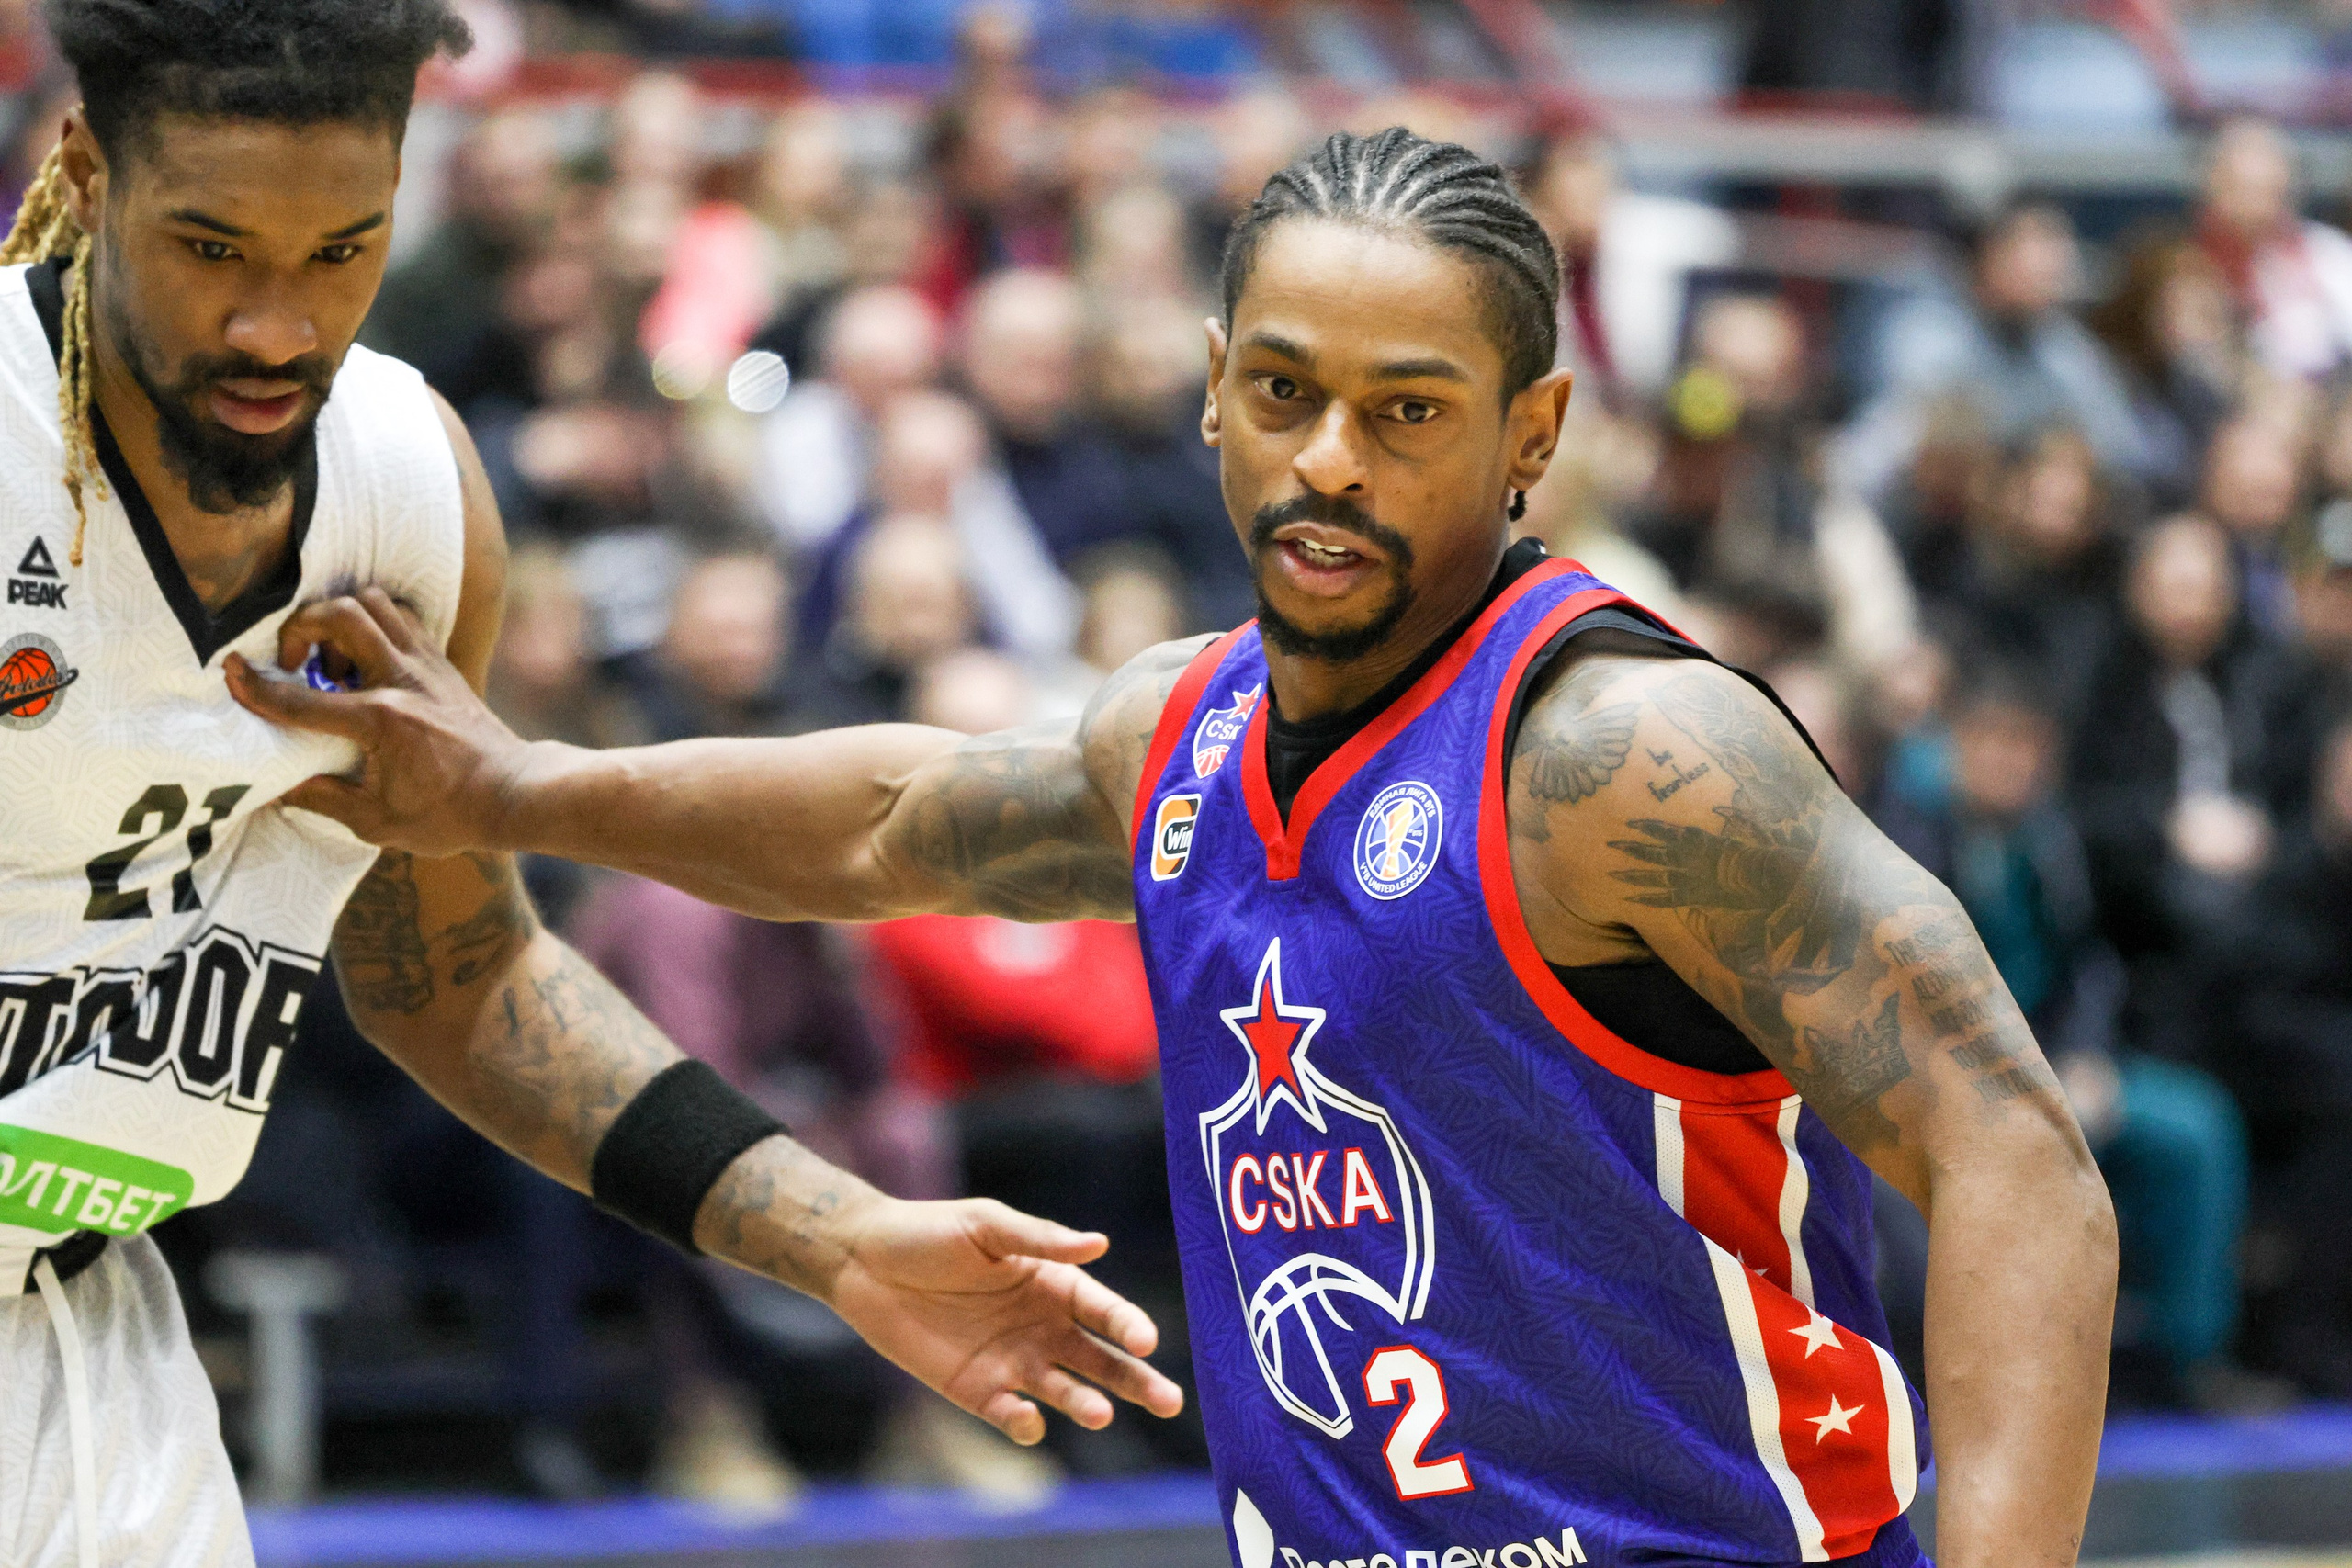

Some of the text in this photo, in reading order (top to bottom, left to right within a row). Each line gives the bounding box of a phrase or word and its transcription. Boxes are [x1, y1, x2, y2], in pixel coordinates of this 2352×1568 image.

[7, 578, 69, 610] PEAK
[1369, 787, 1437, 818] ЕДИНАЯ ЛИГА ВТБ
[83, 784, 253, 921] 21
[1360, 861, 1428, 894] VTB UNITED LEAGUE
[1228, 1146, 1394, 1235] CSKA
[1361, 1343, 1475, 1502] 2
